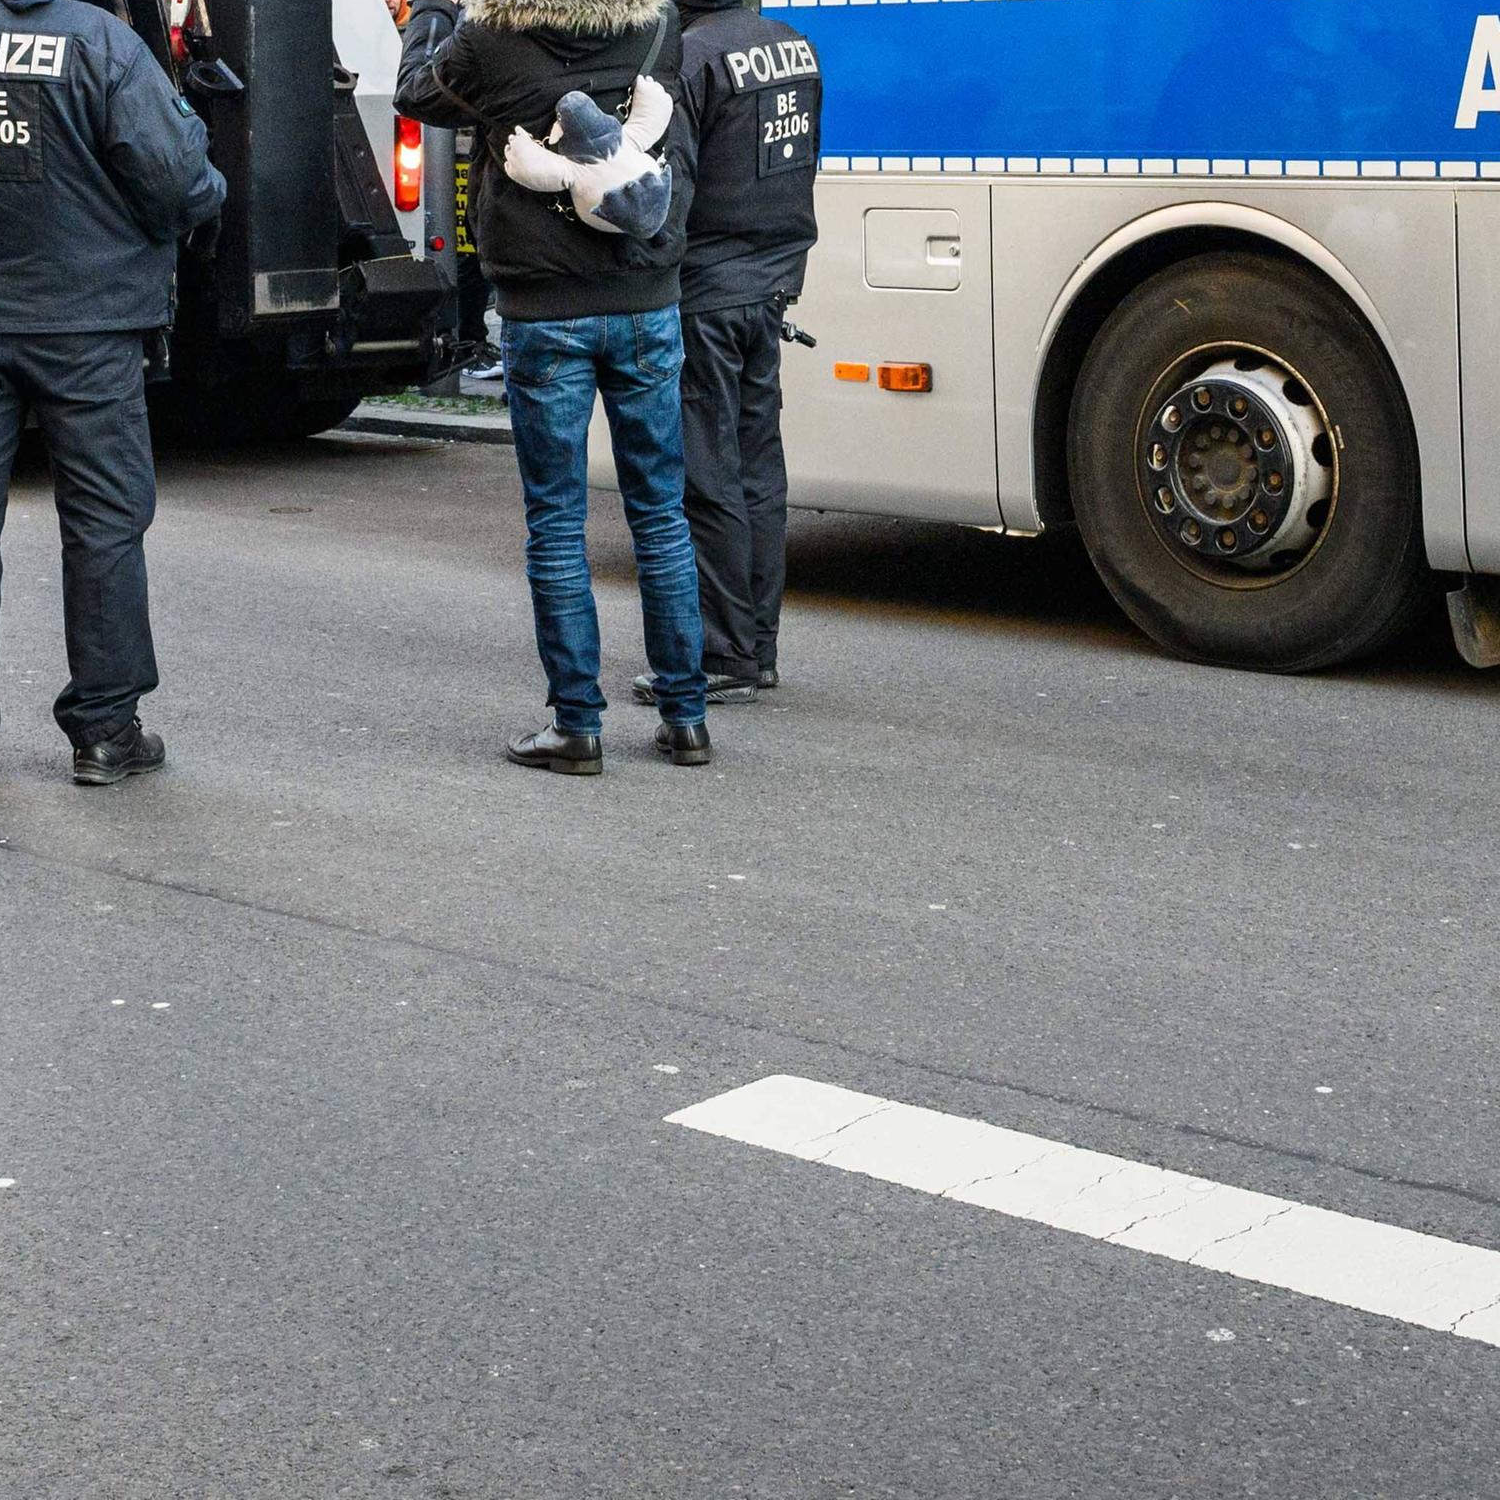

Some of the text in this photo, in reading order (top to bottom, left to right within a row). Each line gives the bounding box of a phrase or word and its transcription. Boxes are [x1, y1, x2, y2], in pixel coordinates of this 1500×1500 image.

[726, 39, 819, 89] POLIZEI
[776, 90, 798, 117] BE
[763, 111, 810, 145] 23106
